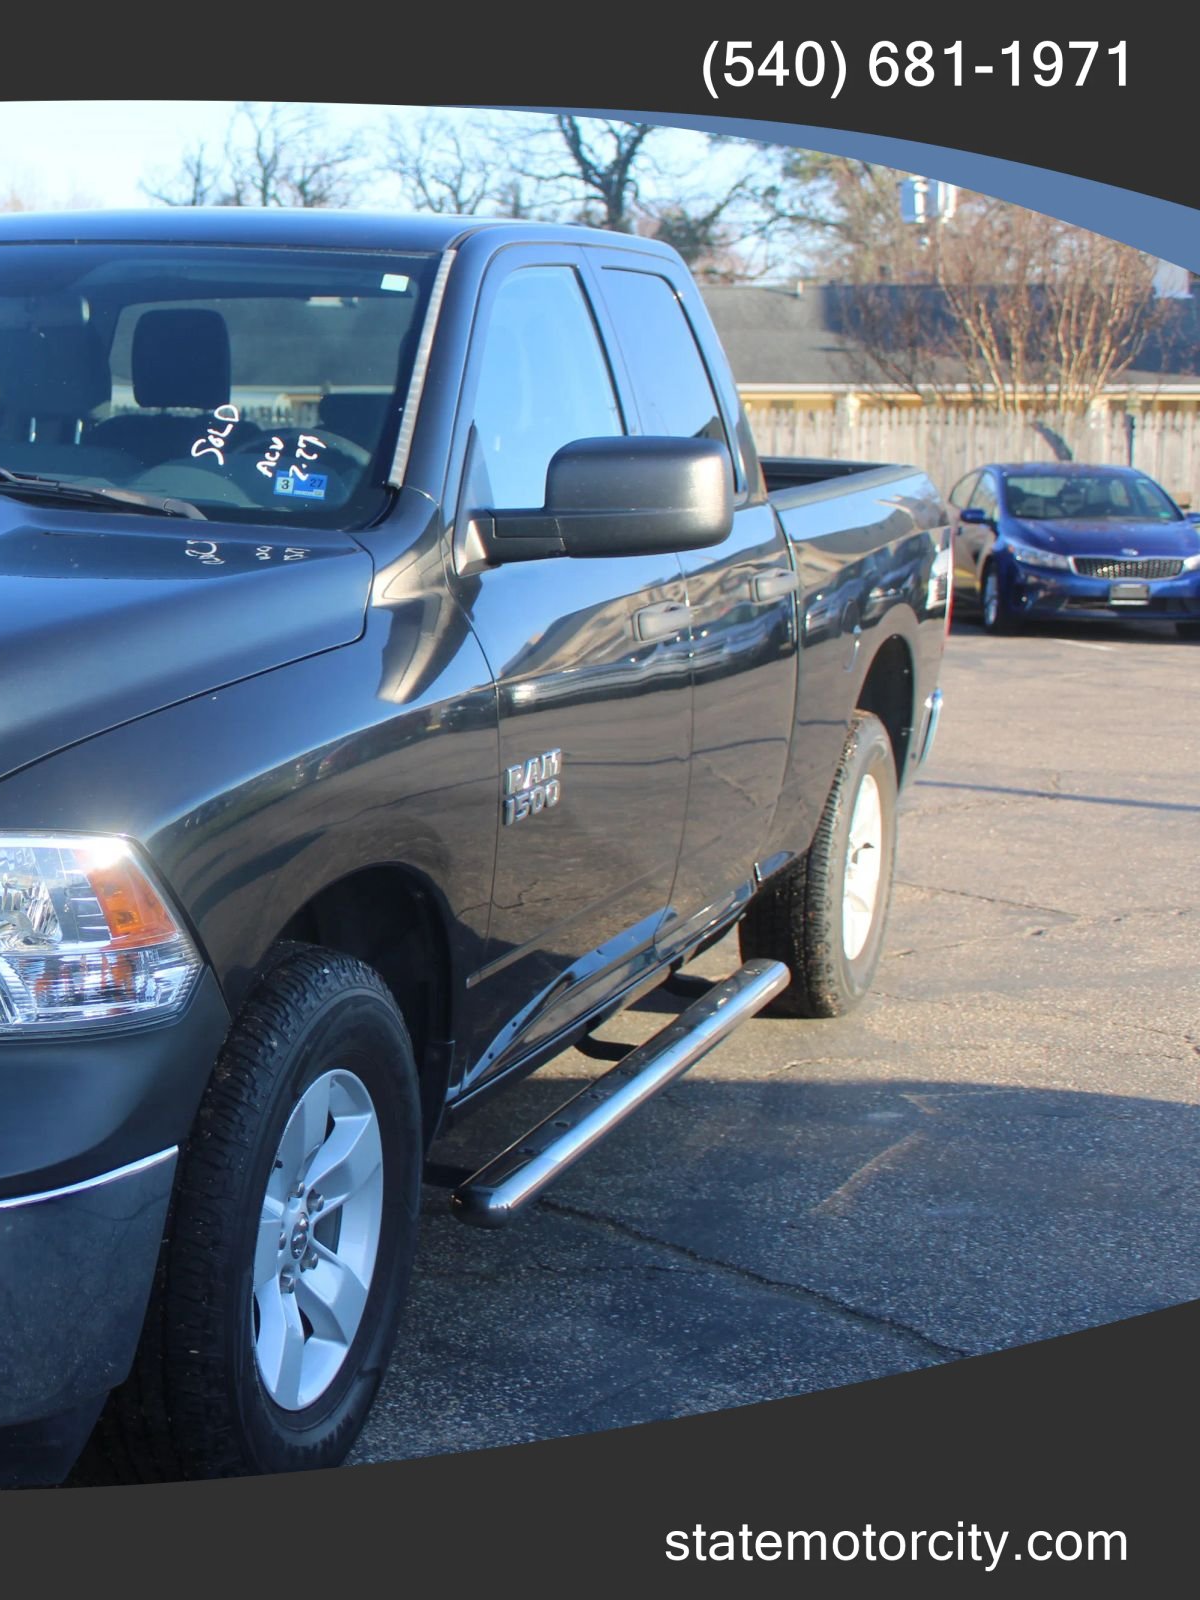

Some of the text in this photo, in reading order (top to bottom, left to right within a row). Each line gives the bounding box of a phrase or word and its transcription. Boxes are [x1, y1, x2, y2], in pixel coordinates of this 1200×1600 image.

[280, 477, 325, 491] 3 27
[503, 748, 562, 797] RAM
[503, 779, 561, 827] 1500
